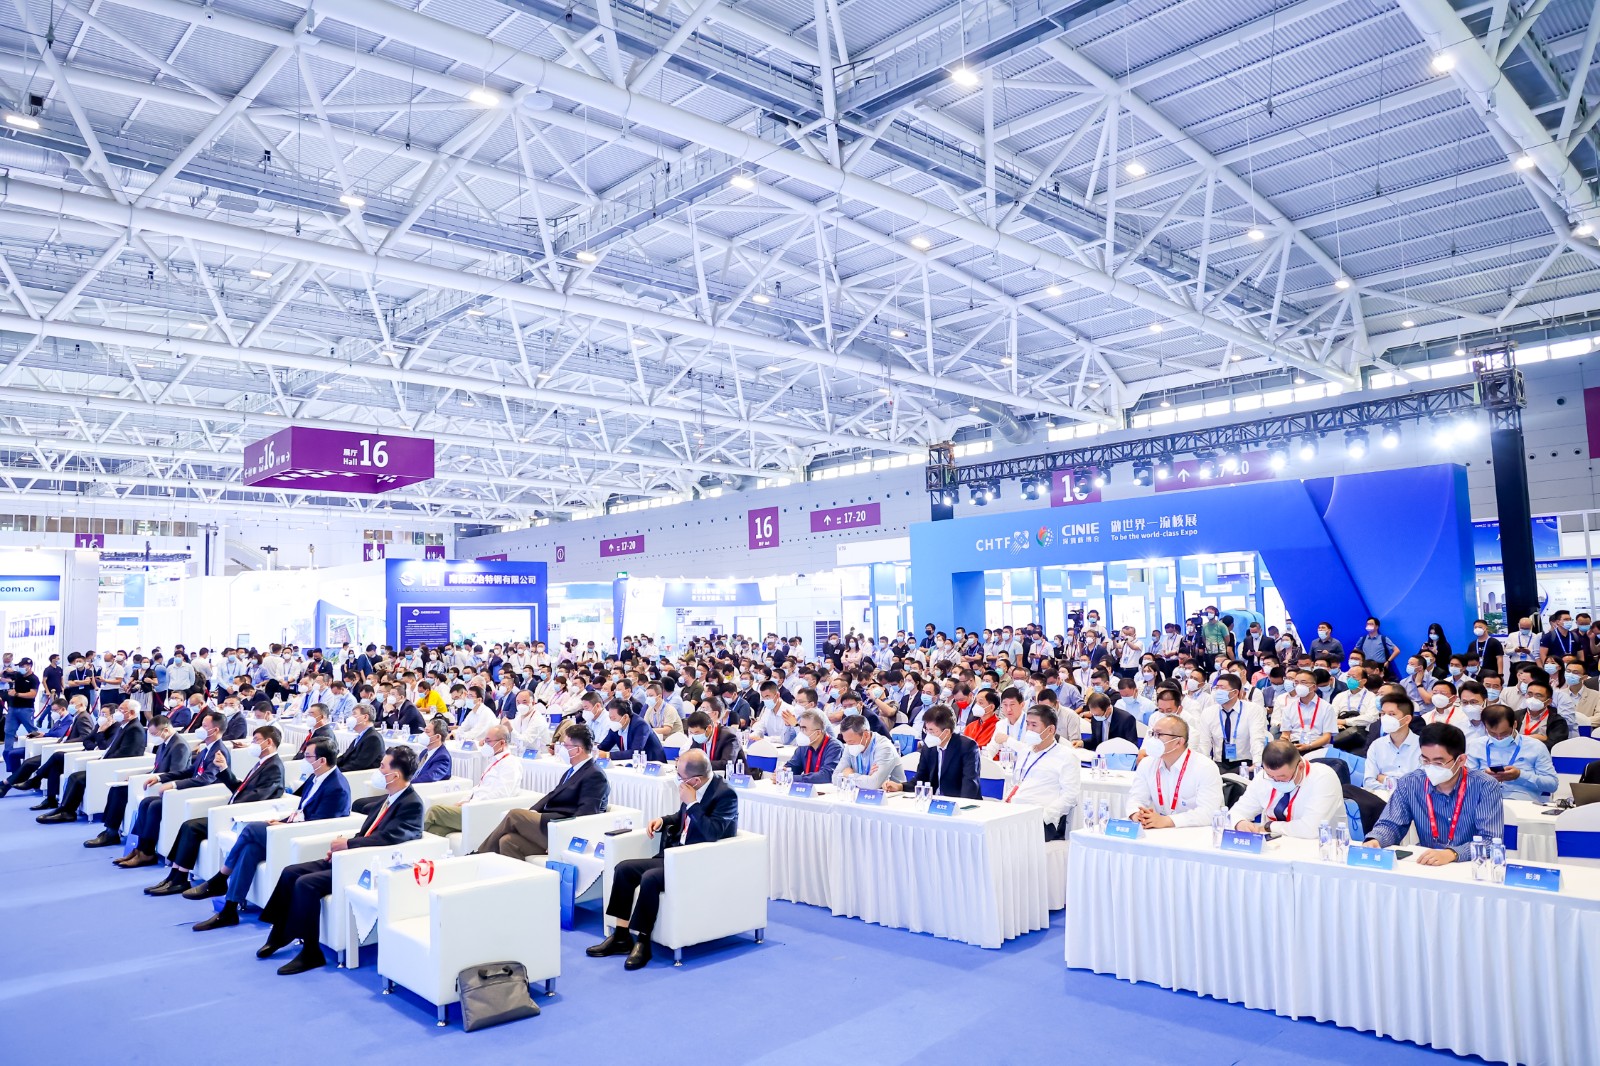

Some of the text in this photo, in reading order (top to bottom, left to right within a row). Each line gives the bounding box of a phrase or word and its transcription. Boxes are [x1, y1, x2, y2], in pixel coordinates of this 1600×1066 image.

[264, 441, 275, 470] 16
[360, 440, 389, 468] 16
[343, 458, 358, 466] Hall
[844, 510, 867, 523] 17-20
[1111, 513, 1198, 533] 做世界一流核展
[755, 515, 773, 539] 16
[1062, 522, 1100, 537] CINIE
[1128, 532, 1140, 540] the
[1140, 529, 1180, 539] world-class
[1181, 529, 1198, 538] Expo
[621, 540, 636, 551] 17-20
[975, 537, 1011, 552] CHTF
